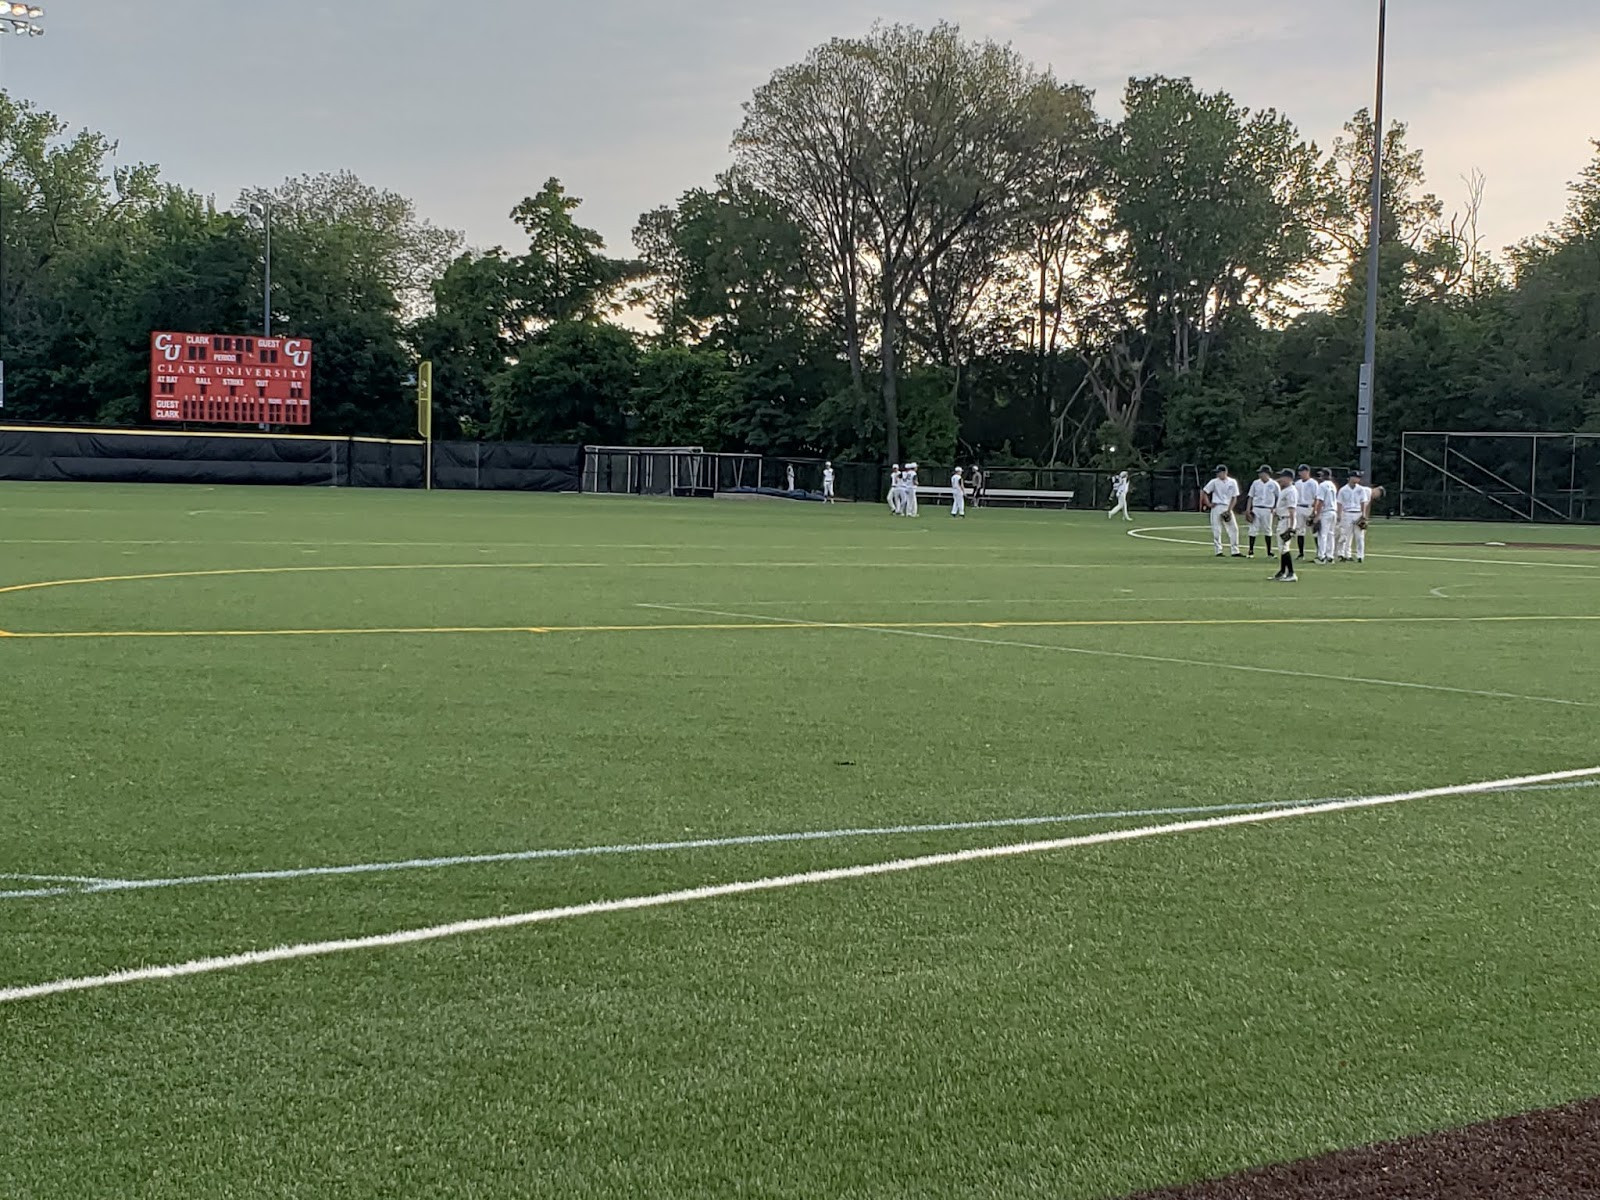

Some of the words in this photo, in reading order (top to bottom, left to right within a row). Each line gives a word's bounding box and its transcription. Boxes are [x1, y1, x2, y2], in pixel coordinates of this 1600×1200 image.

[186, 336, 209, 344] CLARK
[155, 334, 181, 360] CU
[284, 341, 310, 366] CU
[157, 364, 206, 374] CLARK
[216, 366, 307, 379] UNIVERSITY
[156, 400, 179, 408] GUEST
[156, 410, 179, 418] CLARK
